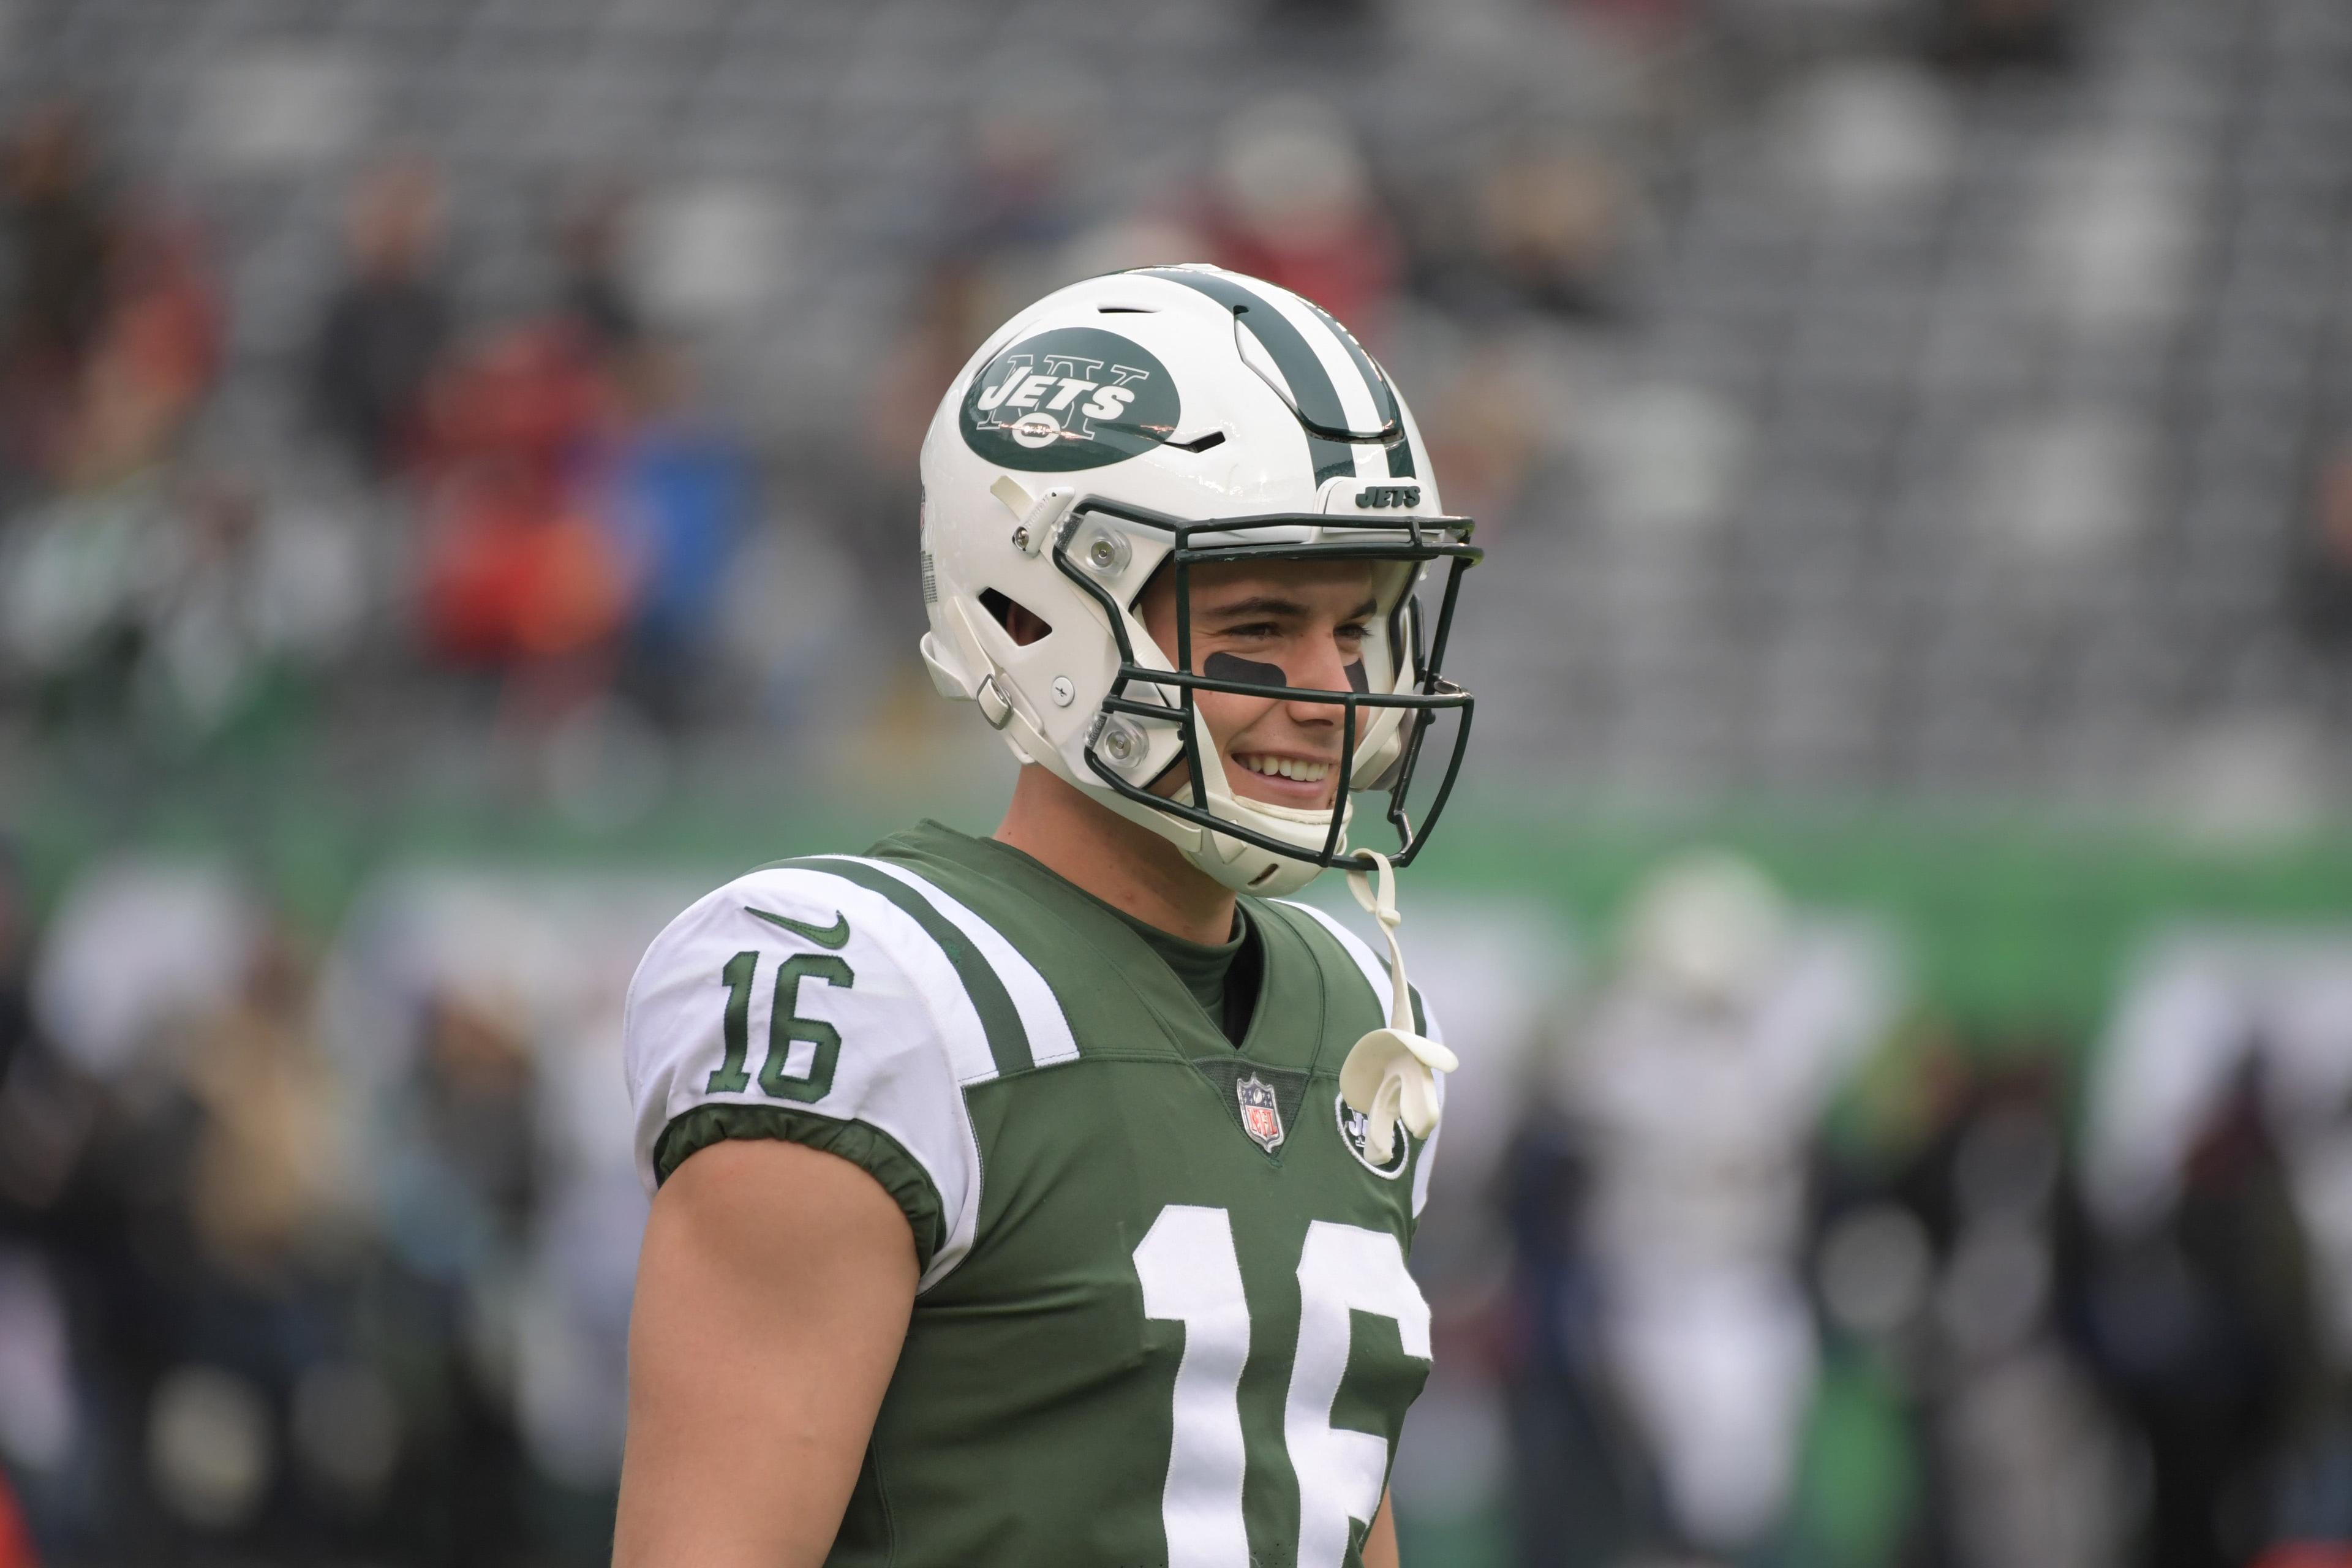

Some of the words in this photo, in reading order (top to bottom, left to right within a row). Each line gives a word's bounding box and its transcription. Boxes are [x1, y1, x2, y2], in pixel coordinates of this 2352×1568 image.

[978, 366, 1135, 420] JETS
[1355, 486, 1420, 508] JETS
[705, 950, 854, 1104] 16
[1246, 1107, 1278, 1138] NFL
[1132, 1204, 1433, 1568] 16
